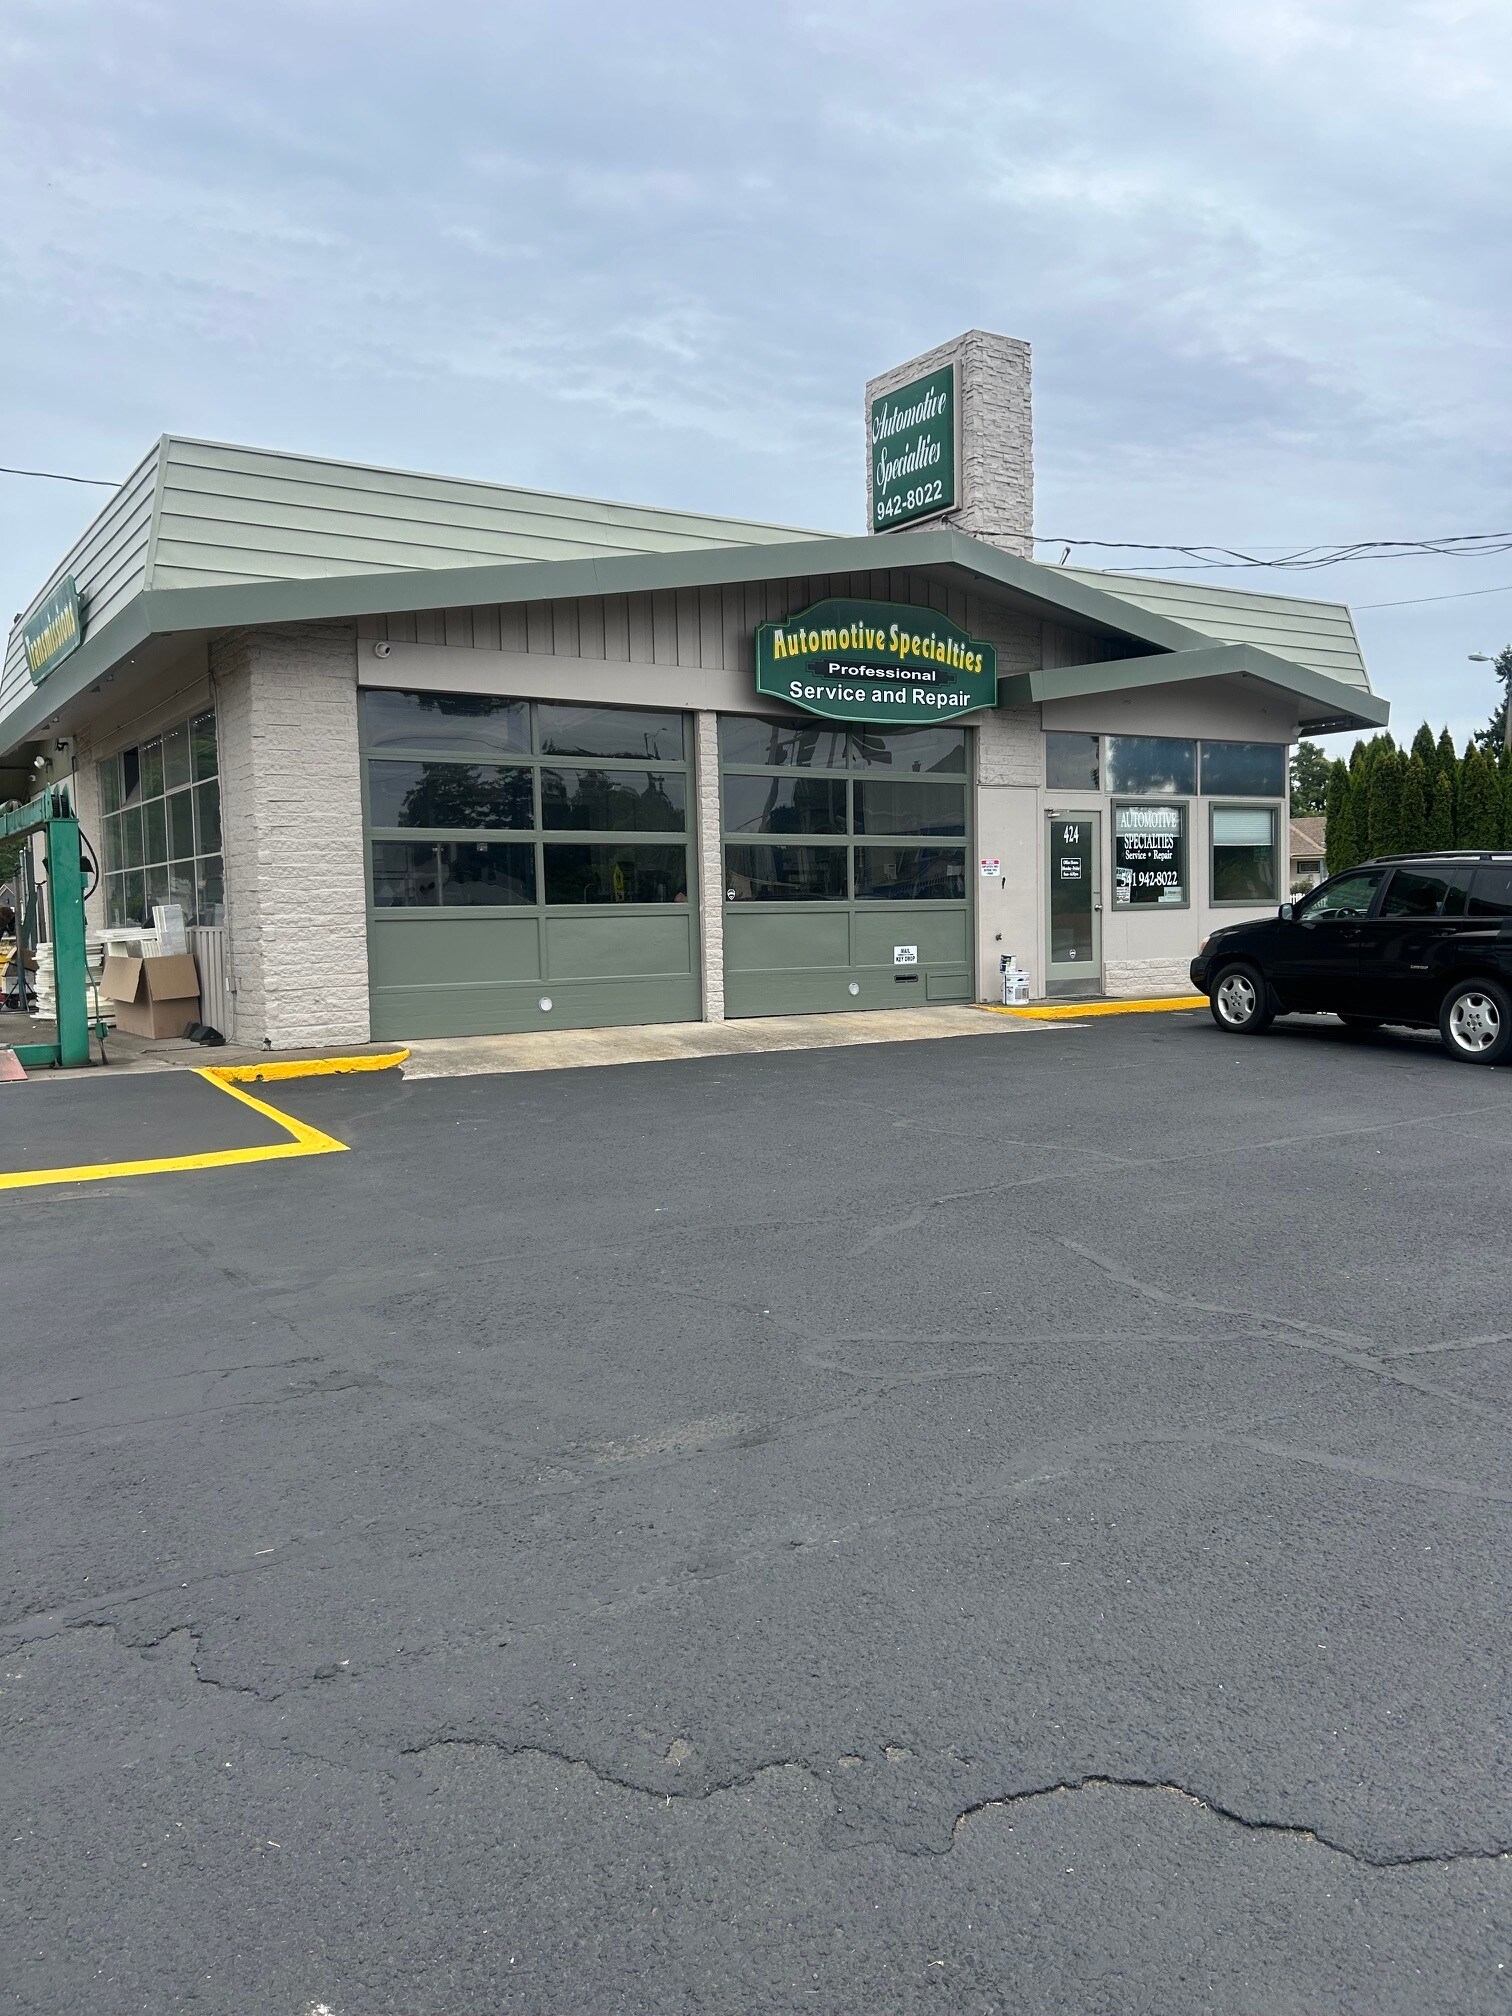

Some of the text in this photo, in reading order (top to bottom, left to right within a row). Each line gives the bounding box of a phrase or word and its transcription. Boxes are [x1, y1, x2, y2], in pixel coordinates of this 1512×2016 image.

[872, 386, 947, 445] Automotive
[876, 434, 941, 495] Specialties
[877, 479, 943, 521] 942-8022
[773, 620, 983, 673] Automotive Specialties
[828, 662, 936, 682] Professional
[789, 681, 971, 709] Service and Repair
[1120, 811, 1177, 828] AUTOMOTIVE
[1063, 825, 1079, 844] 424
[1124, 833, 1174, 849] SPECIALTIES
[1125, 849, 1173, 862] Service Repair
[1120, 871, 1137, 888] 541
[1138, 870, 1178, 887] 942-8022
